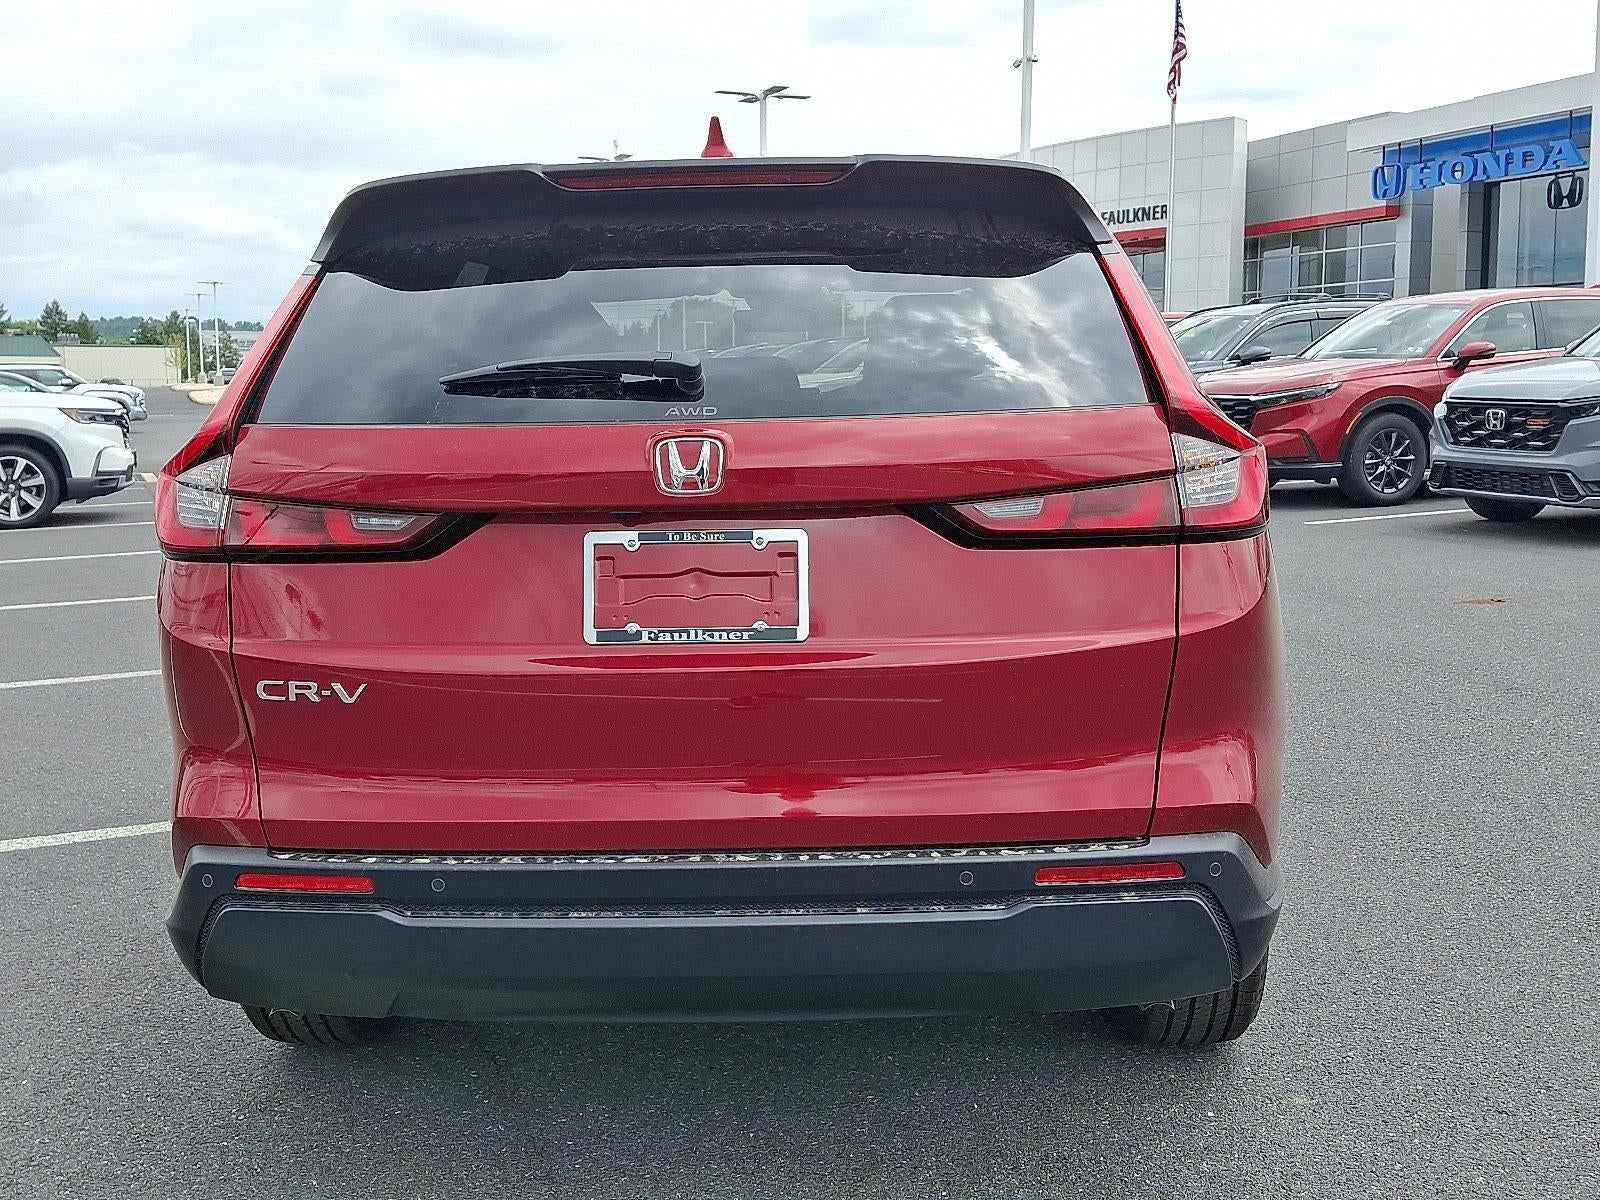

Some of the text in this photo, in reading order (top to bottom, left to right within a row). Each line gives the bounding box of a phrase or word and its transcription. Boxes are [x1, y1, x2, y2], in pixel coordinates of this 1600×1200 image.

[1407, 138, 1588, 191] HONDA
[1100, 203, 1168, 226] FAULKNER
[664, 406, 718, 417] AWD
[665, 531, 725, 541] To Be Sure
[639, 629, 755, 642] Faulkner
[256, 680, 368, 704] CR-V
